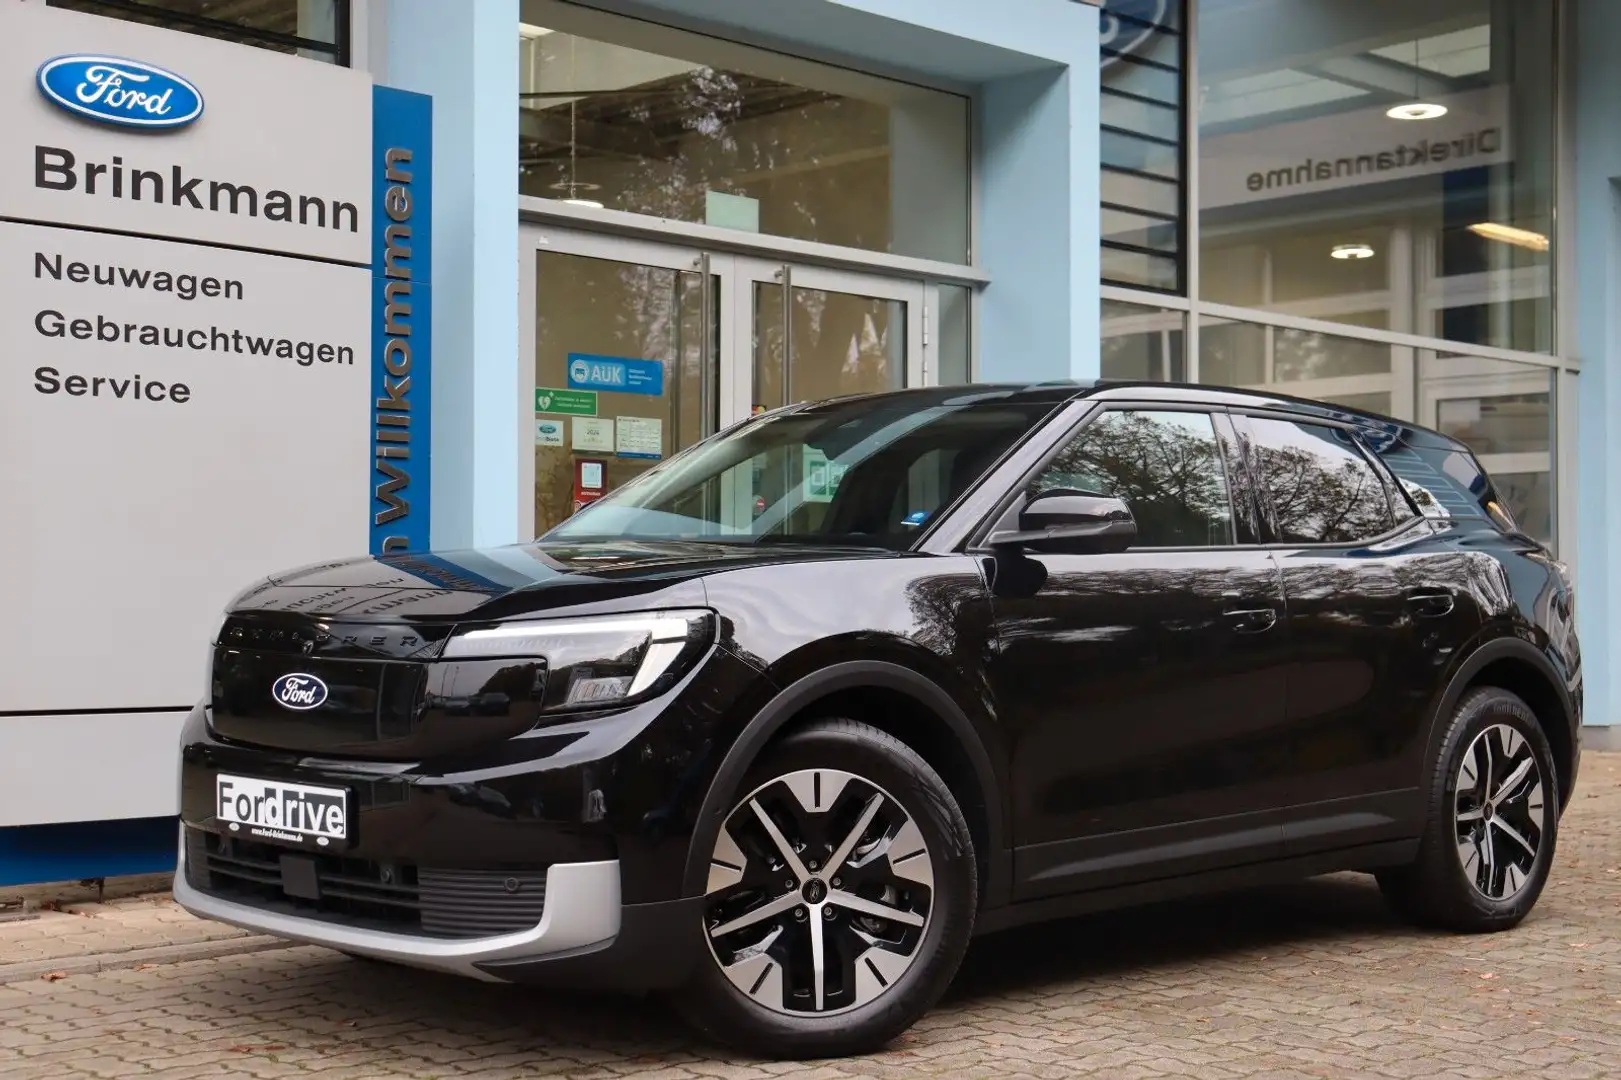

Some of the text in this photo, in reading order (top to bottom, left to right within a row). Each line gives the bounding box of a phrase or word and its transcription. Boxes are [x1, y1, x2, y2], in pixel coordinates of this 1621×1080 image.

[76, 64, 173, 116] Ford
[35, 145, 359, 233] Brinkmann
[34, 252, 244, 301] Neuwagen
[34, 309, 355, 367] Gebrauchtwagen
[375, 146, 414, 526] Willkommen
[34, 366, 191, 404] Service
[281, 676, 317, 704] Ford
[218, 780, 345, 835] Fordrive
